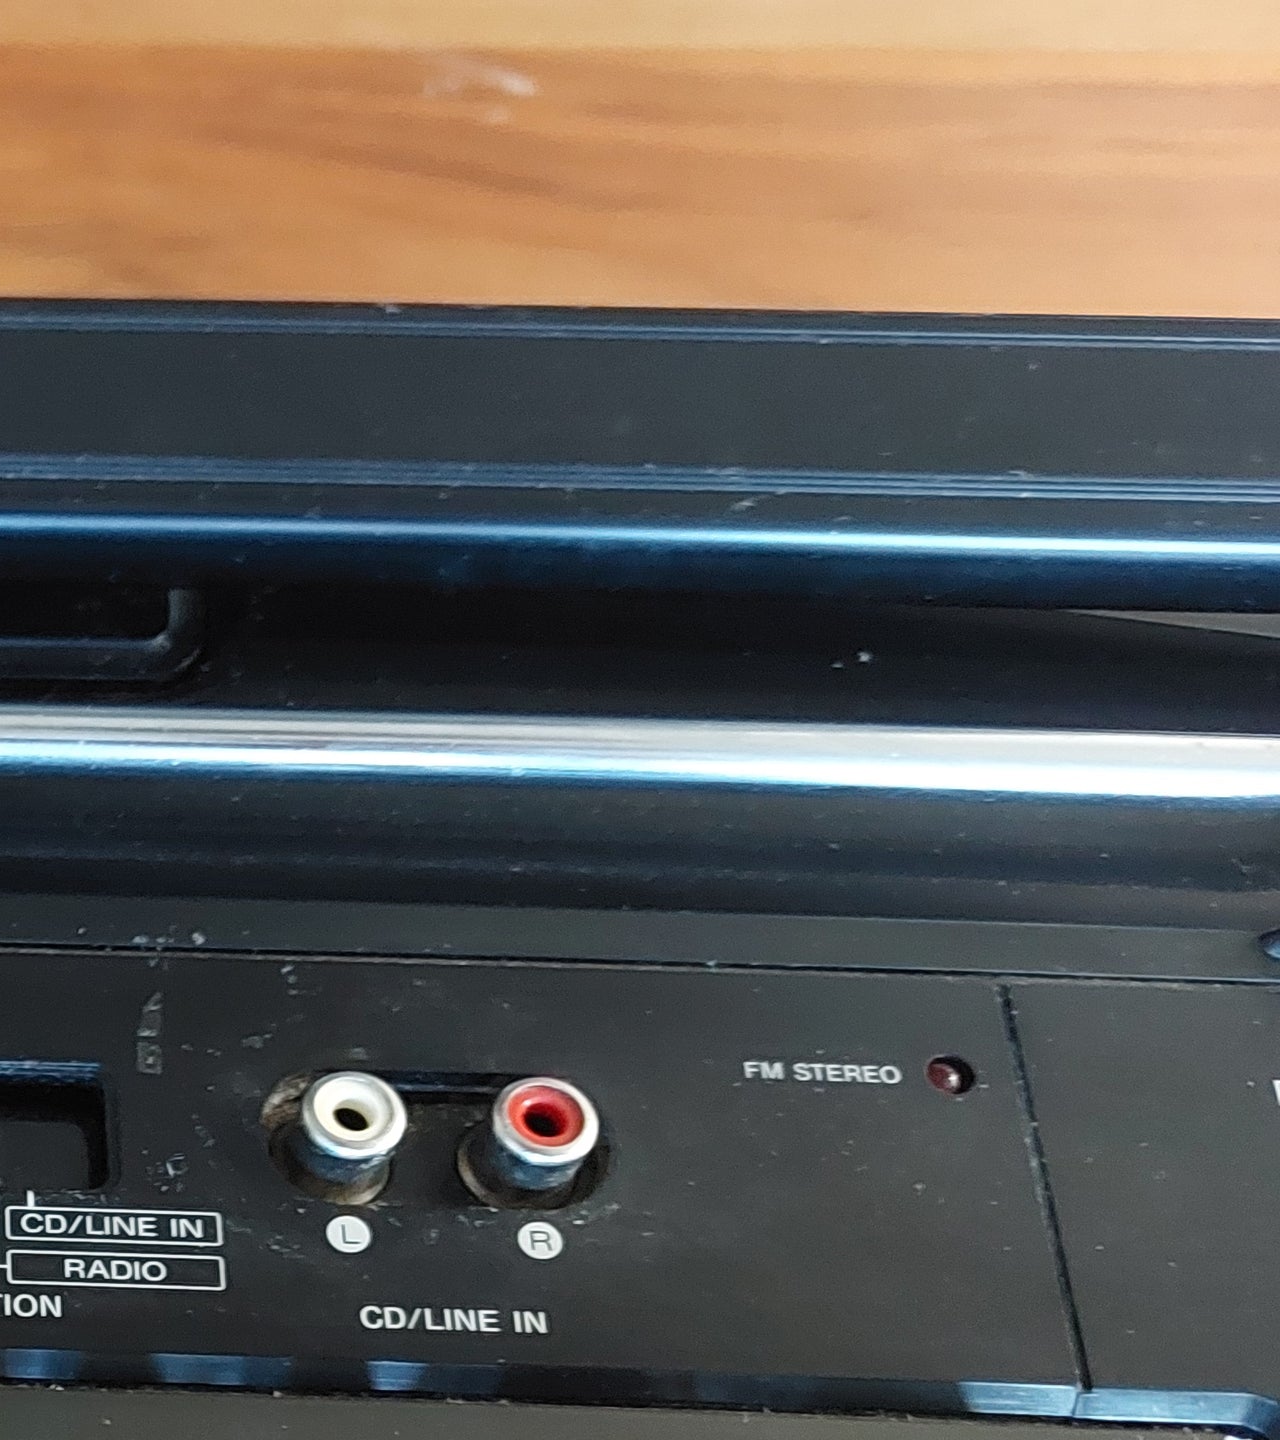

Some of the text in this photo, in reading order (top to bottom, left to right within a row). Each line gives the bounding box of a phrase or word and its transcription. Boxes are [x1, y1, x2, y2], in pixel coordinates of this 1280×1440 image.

[743, 1061, 902, 1084] FM STEREO
[20, 1213, 204, 1238] CD/LINE IN
[341, 1223, 361, 1245] L
[529, 1231, 552, 1251] R
[63, 1259, 168, 1282] RADIO
[359, 1306, 549, 1334] CD/LINE IN
